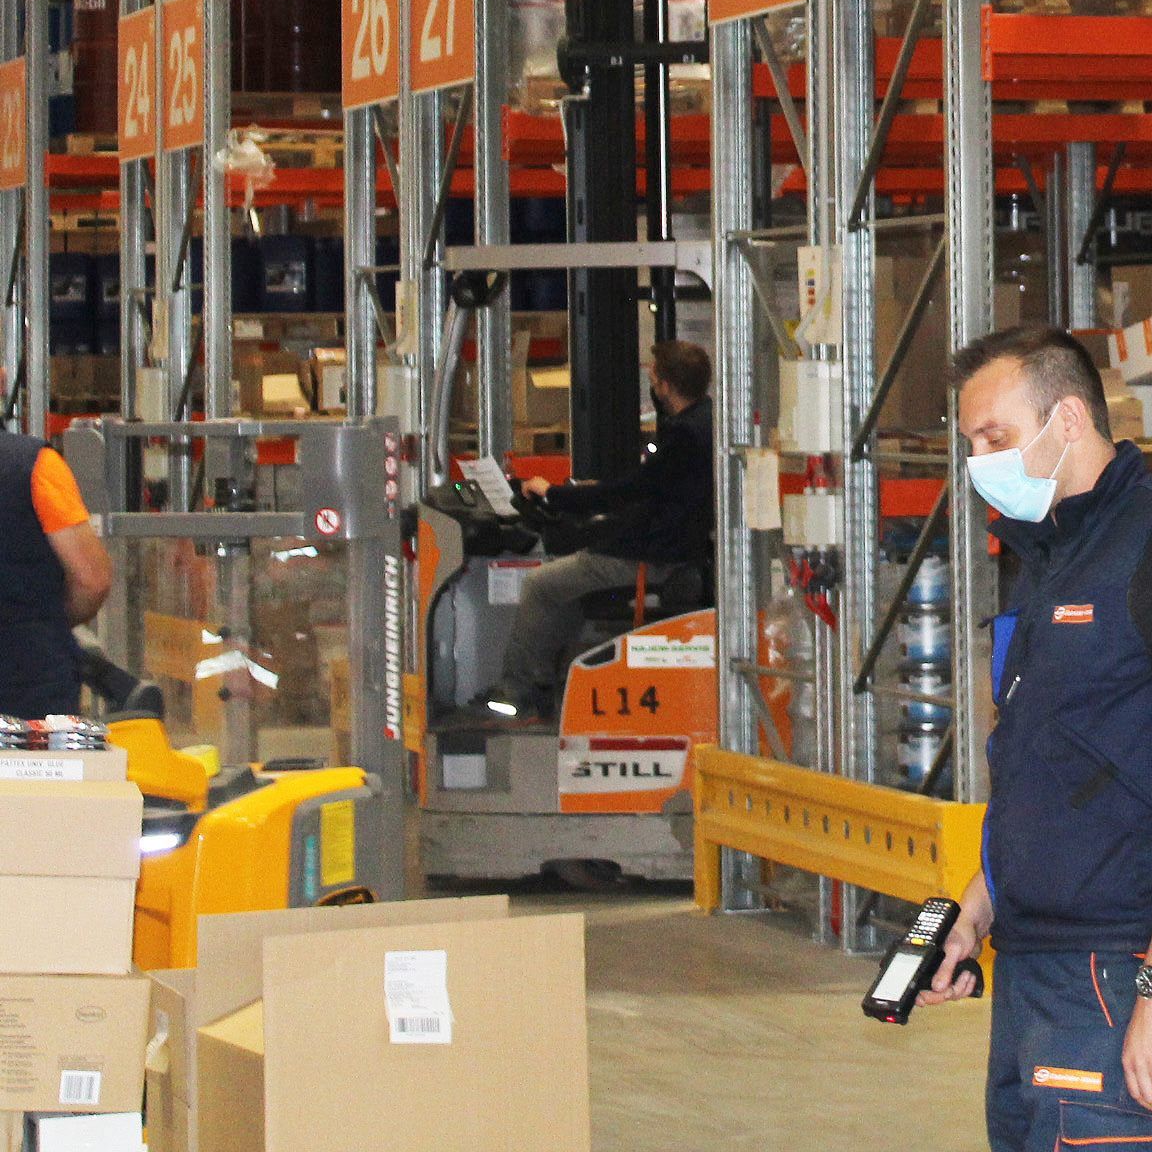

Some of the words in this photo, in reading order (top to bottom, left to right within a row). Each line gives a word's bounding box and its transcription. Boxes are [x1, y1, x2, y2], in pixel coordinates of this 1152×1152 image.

[124, 42, 150, 138] 24
[168, 25, 197, 127] 25
[384, 554, 400, 740] JUNGHEINRICH
[572, 762, 672, 777] STILL
